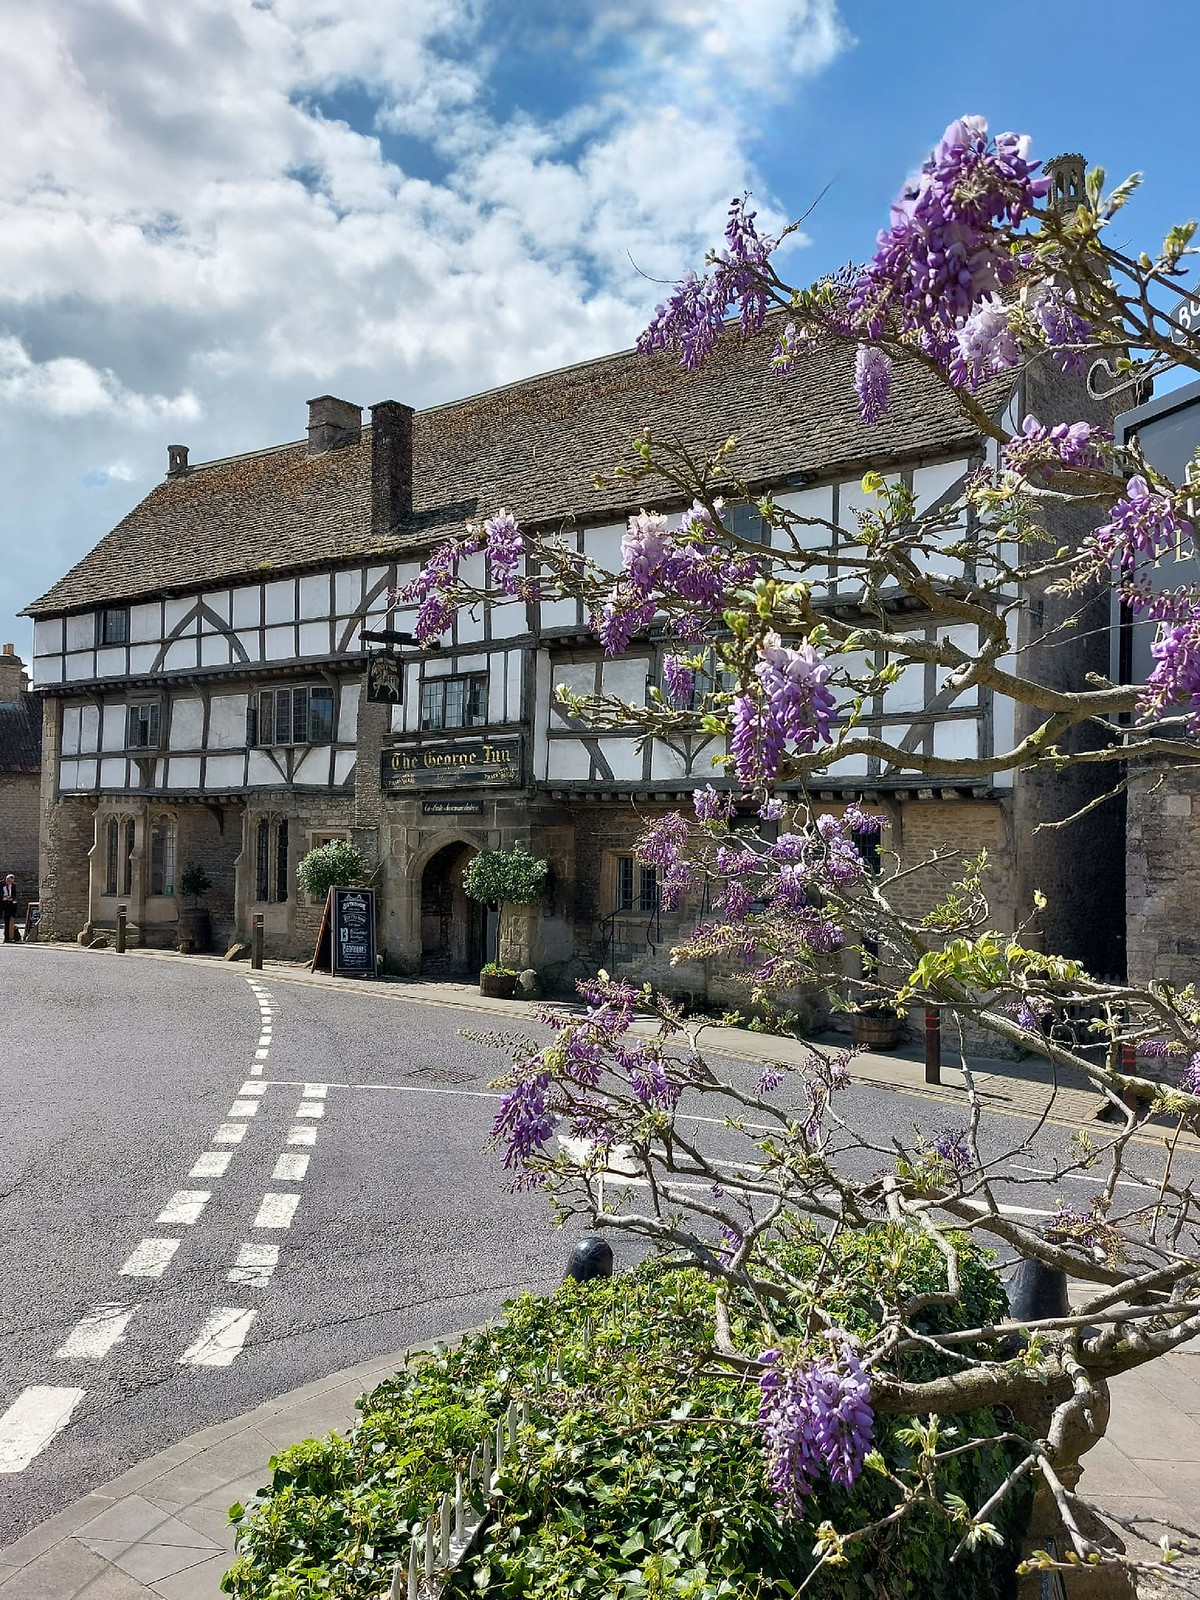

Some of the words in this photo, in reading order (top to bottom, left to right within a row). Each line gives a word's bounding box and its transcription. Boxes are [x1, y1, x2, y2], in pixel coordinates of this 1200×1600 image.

[391, 751, 419, 771] The
[423, 749, 478, 770] George
[482, 745, 511, 764] Inn
[340, 927, 349, 942] 13
